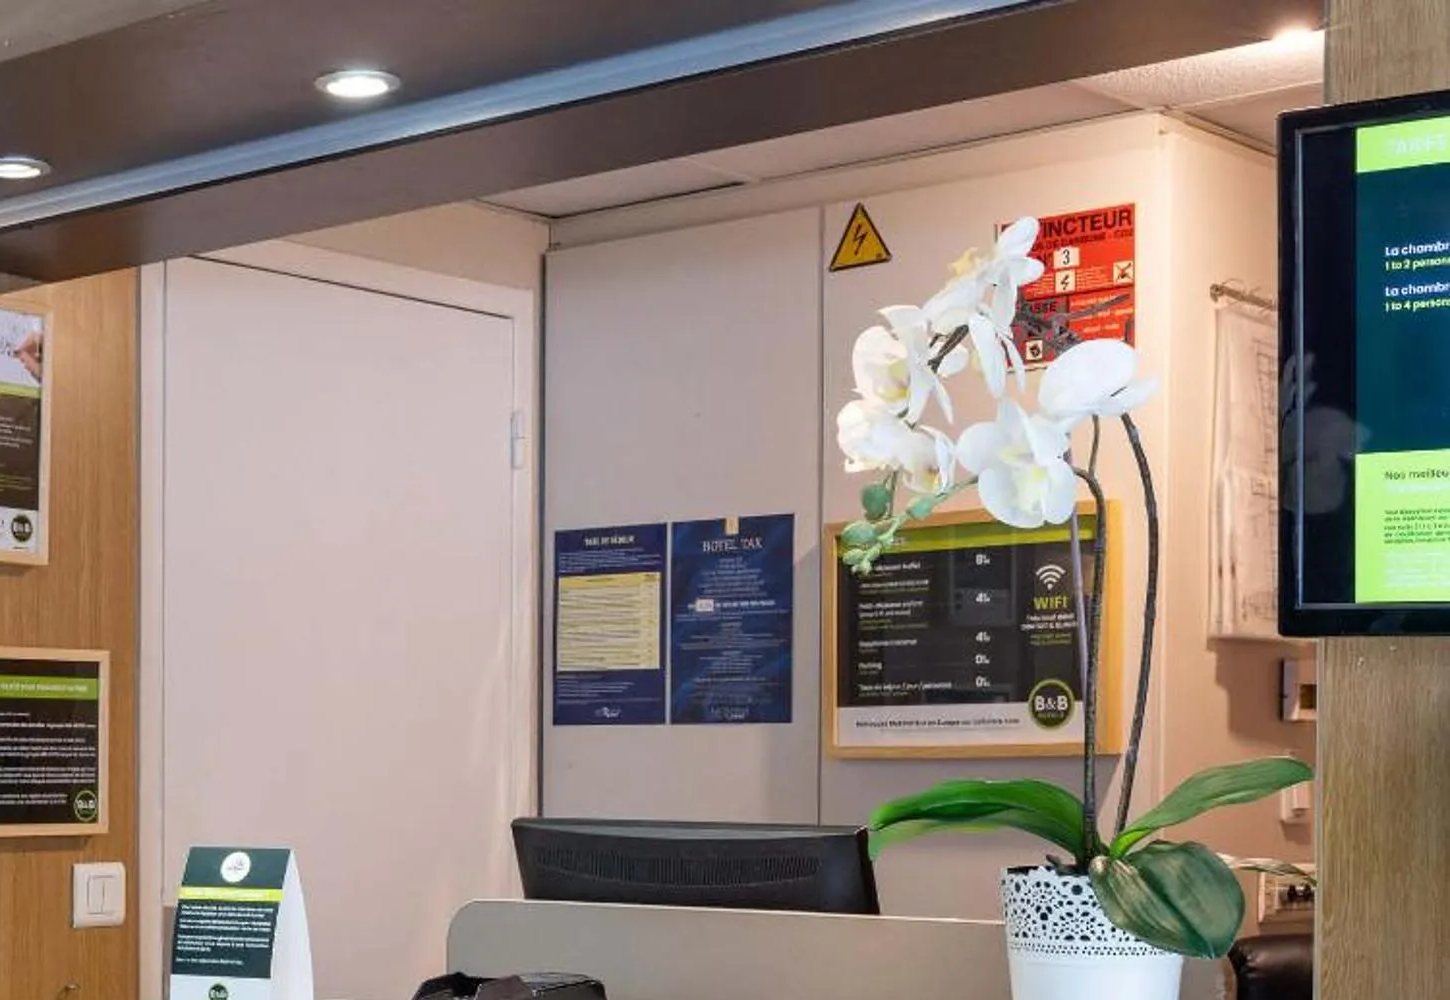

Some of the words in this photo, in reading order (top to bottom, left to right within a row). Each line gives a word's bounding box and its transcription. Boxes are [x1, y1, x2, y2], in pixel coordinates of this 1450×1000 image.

[1039, 208, 1133, 239] INCTEUR
[1061, 248, 1072, 266] 3
[1385, 247, 1399, 256] La
[1391, 260, 1402, 270] to
[1403, 259, 1410, 269] 2
[1385, 287, 1399, 296] La
[1391, 301, 1402, 310] to
[1403, 300, 1411, 310] 4
[702, 540, 738, 552] HOTEL
[1033, 596, 1068, 610] WIFI
[1034, 696, 1068, 711] B&B
